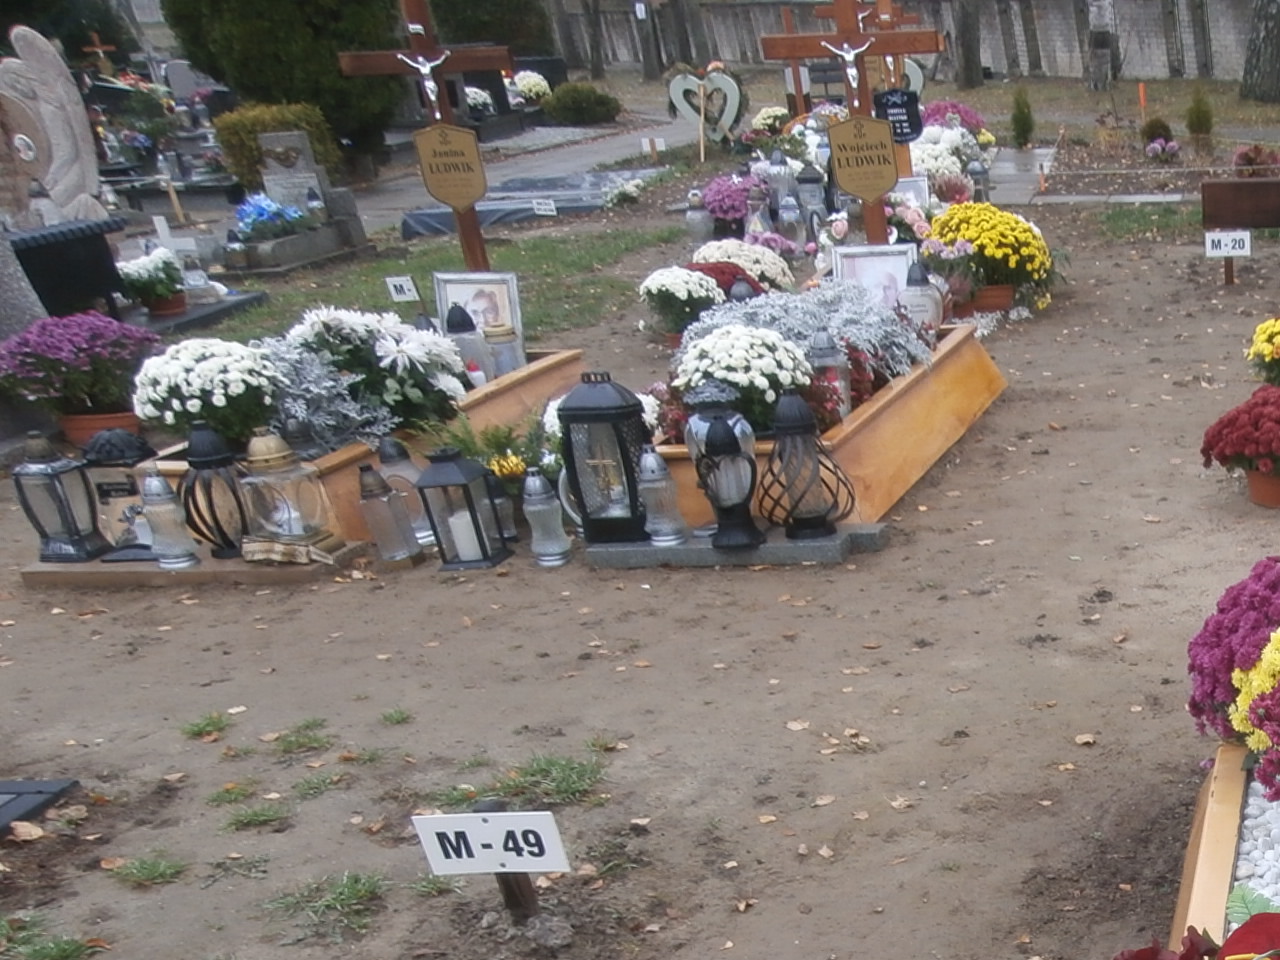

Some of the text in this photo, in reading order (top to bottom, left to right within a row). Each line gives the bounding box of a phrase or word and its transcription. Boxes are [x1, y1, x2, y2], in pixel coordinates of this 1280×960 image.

[431, 148, 466, 158] Janina
[836, 140, 888, 154] Wojciech
[428, 161, 475, 175] LUDWIK
[836, 154, 892, 169] LUDWIK
